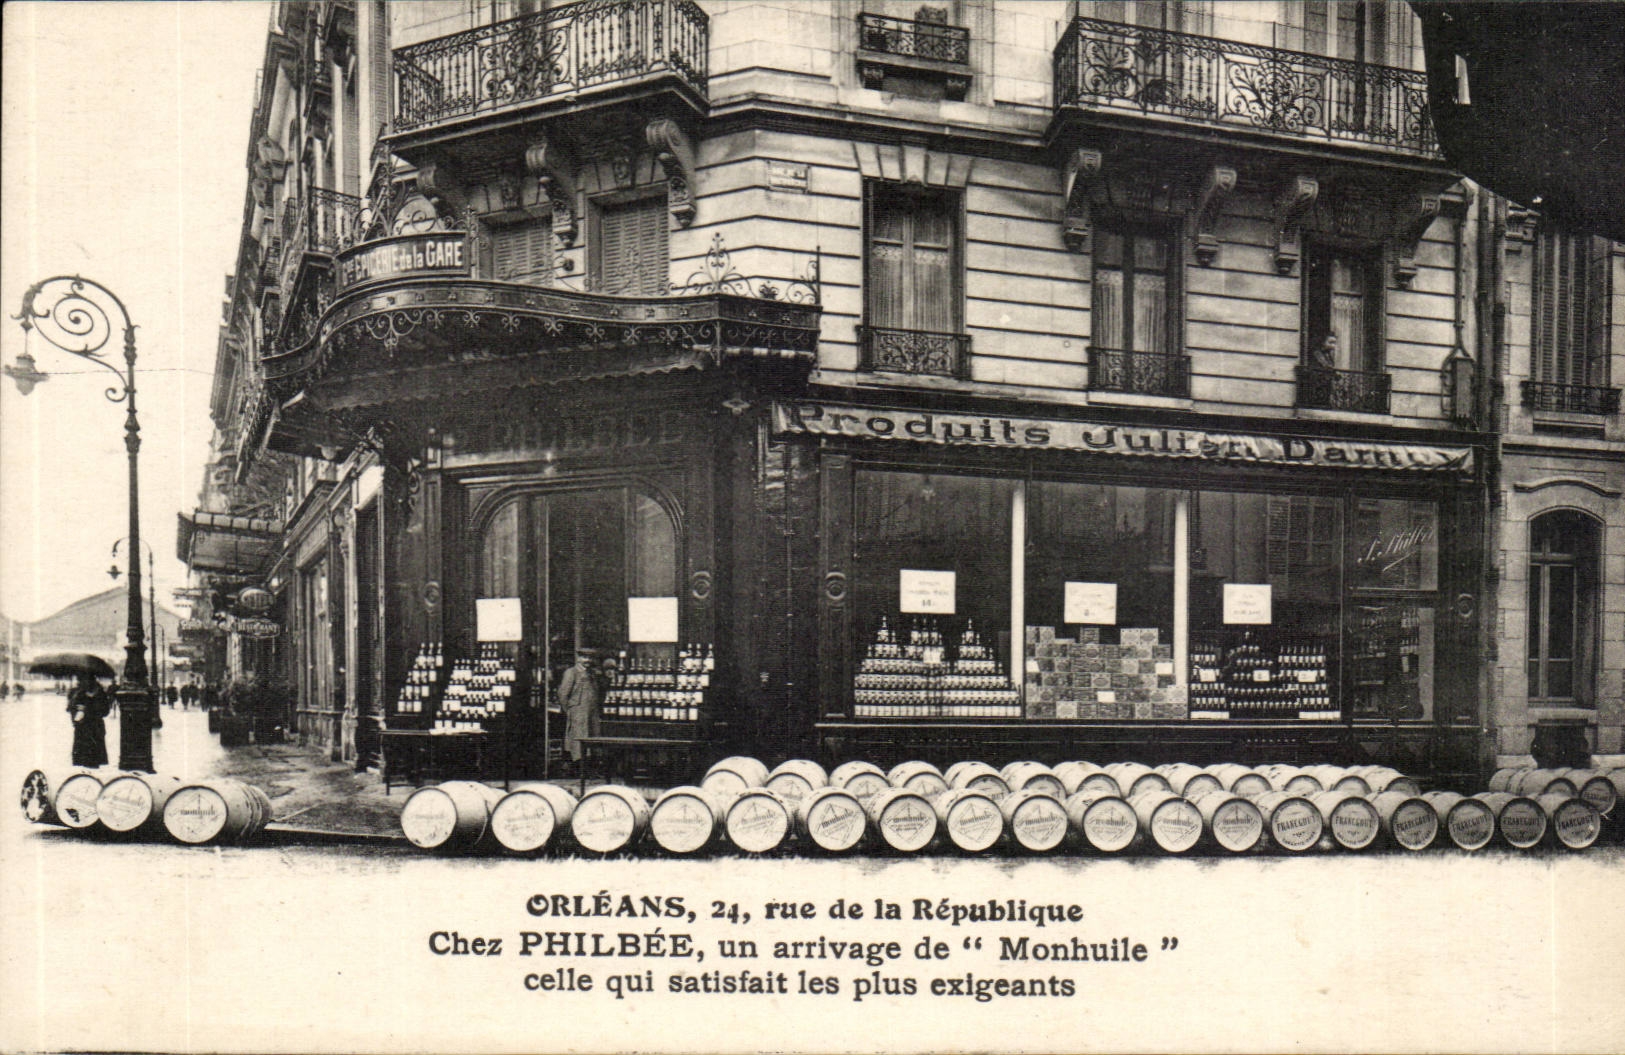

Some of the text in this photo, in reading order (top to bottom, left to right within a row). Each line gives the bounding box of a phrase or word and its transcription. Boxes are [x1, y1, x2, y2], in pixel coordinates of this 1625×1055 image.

[413, 245, 424, 268] la
[425, 240, 464, 266] GARE
[787, 403, 1051, 446] Produits
[1082, 427, 1257, 459] Julien
